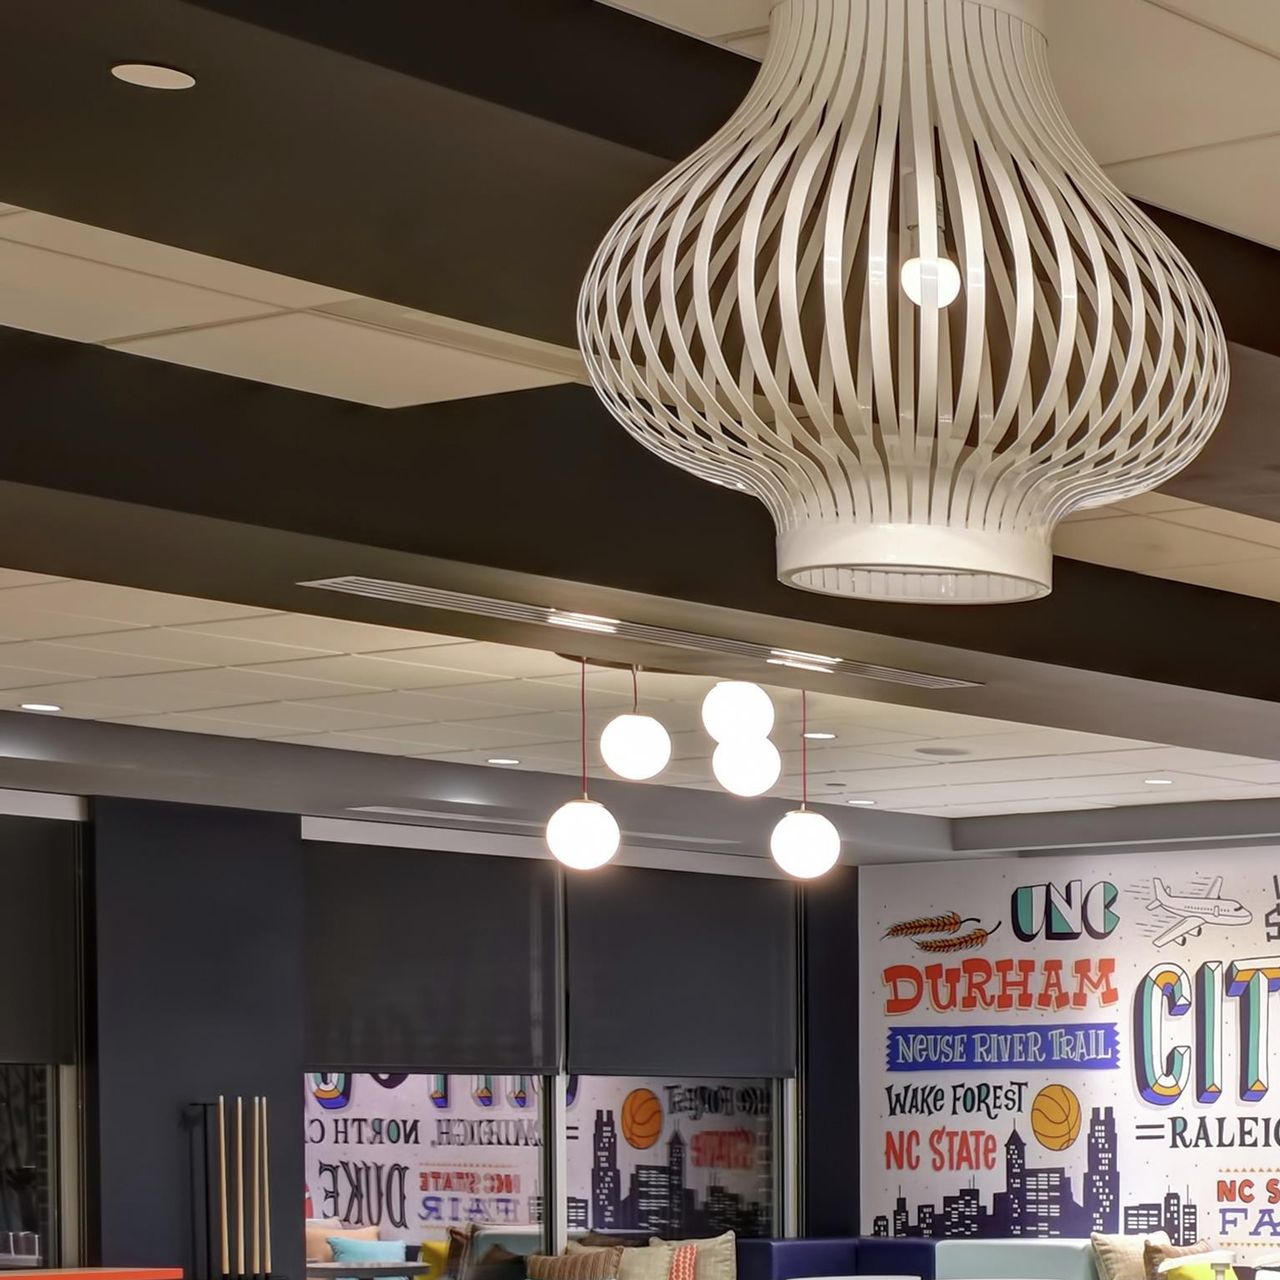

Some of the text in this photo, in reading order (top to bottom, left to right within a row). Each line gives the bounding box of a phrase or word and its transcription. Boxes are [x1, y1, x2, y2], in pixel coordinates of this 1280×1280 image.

[1011, 880, 1120, 942] UNC
[883, 958, 1120, 1015] DURHAM
[972, 1031, 1046, 1063] RIVER
[1049, 1028, 1112, 1062] TRAIL
[951, 1081, 1029, 1120] FOREST
[885, 1130, 921, 1170] NC
[1217, 1179, 1255, 1204] NC
